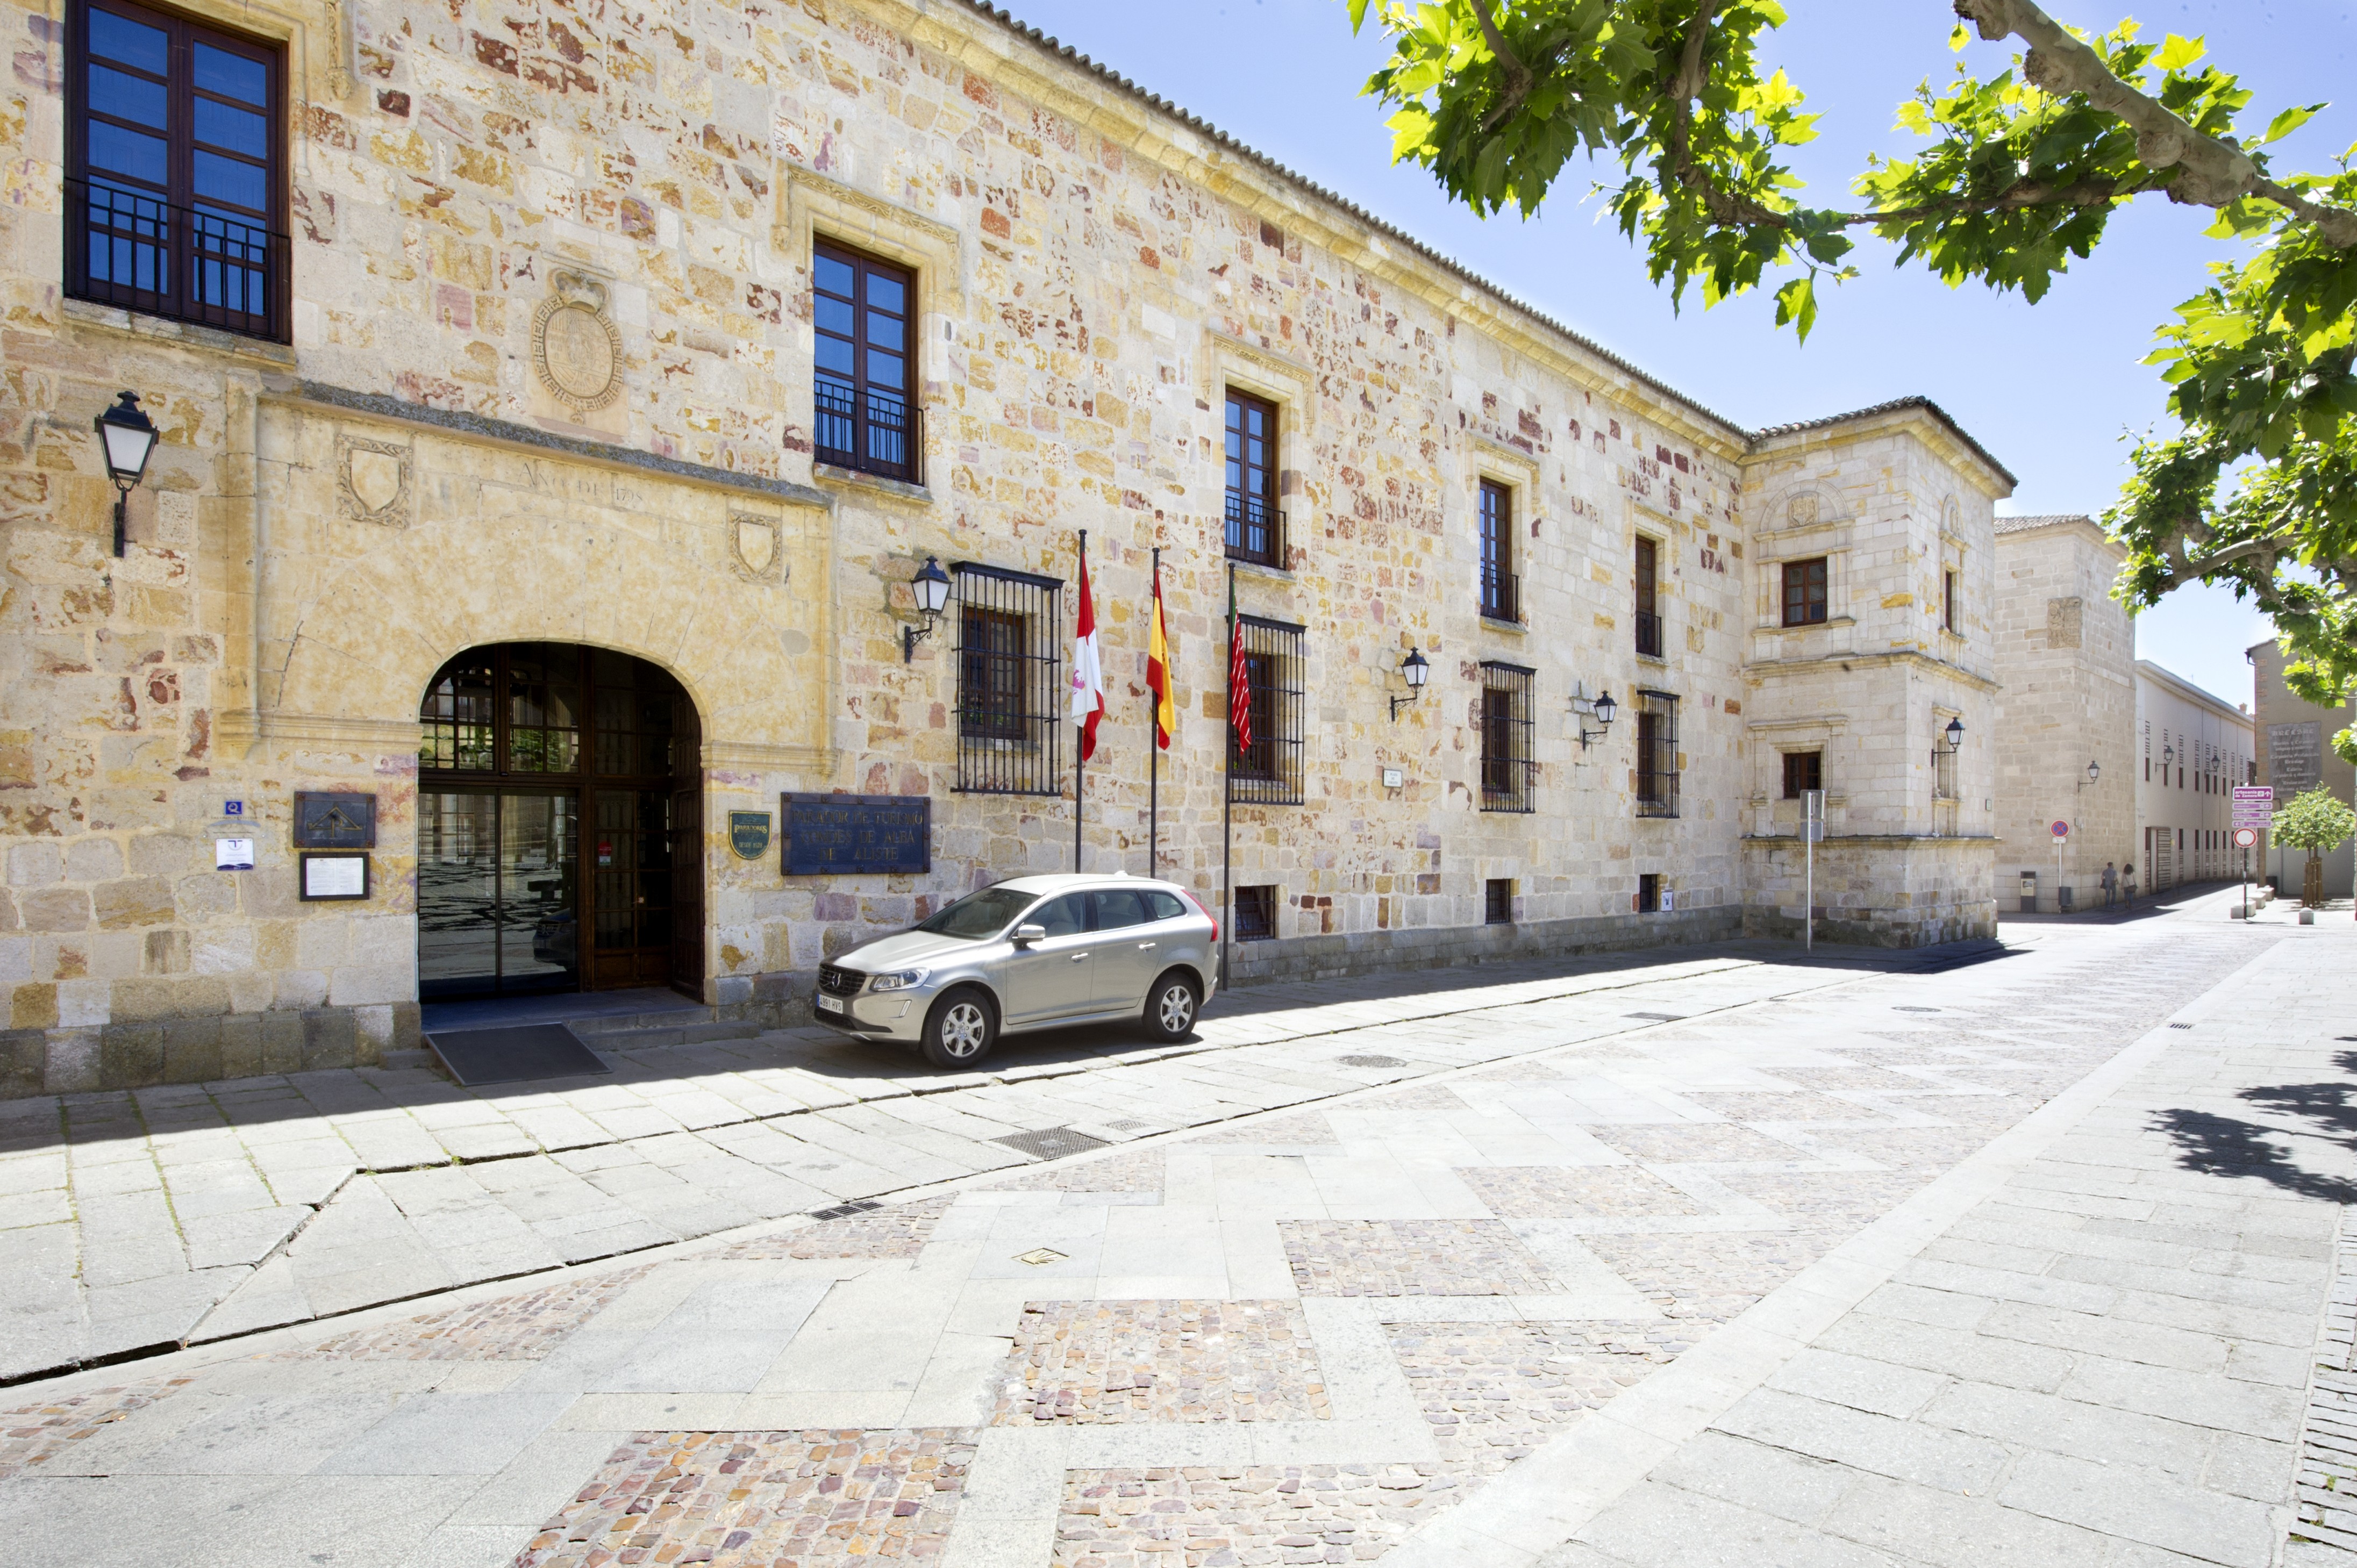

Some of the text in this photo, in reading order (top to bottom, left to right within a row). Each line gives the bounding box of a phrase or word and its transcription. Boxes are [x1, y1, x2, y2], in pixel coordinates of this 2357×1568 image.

[792, 810, 923, 825] PARADOR DE TURISMO
[734, 825, 767, 834] PARADORES
[801, 830, 915, 844] CONDES DE ALBA
[820, 847, 899, 861] DE ALISTE
[819, 996, 841, 1011] 4991 HVS
